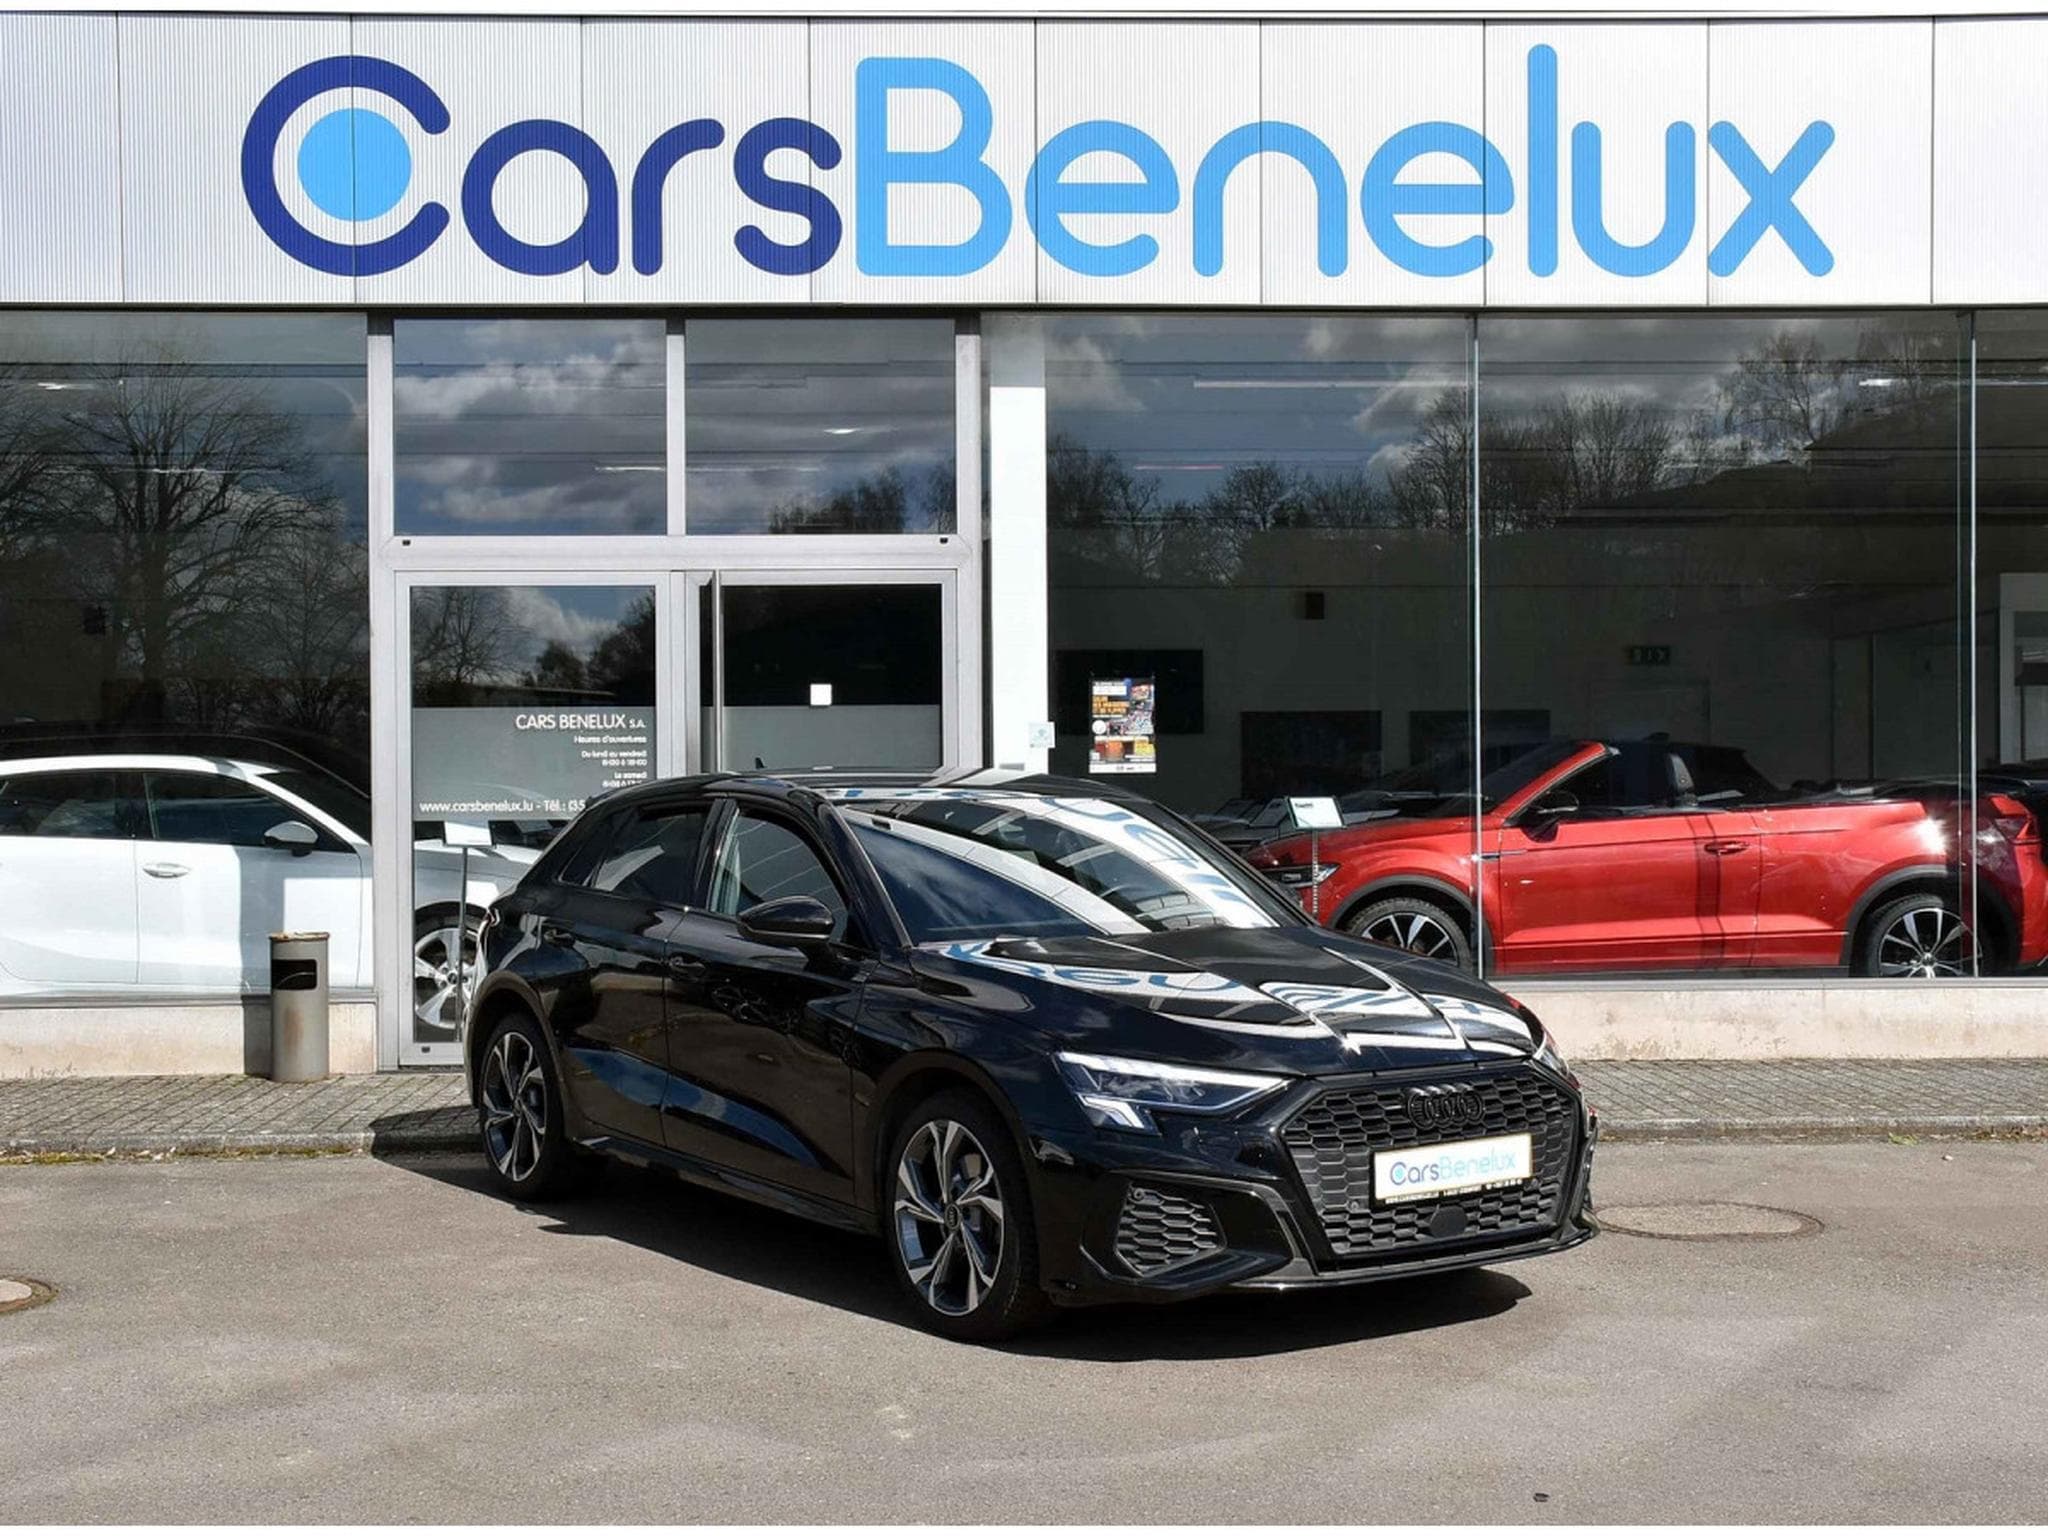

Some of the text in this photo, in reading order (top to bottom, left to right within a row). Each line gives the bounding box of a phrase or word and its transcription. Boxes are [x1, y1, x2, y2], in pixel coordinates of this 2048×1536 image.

[241, 44, 1835, 278] CarsBenelux
[515, 714, 646, 729] CARS BENELUX S.A.
[574, 735, 601, 743] Heures
[581, 750, 592, 758] Du
[419, 800, 533, 813] www.carsbenelux.lu
[1389, 1146, 1517, 1187] CarsBenelux
